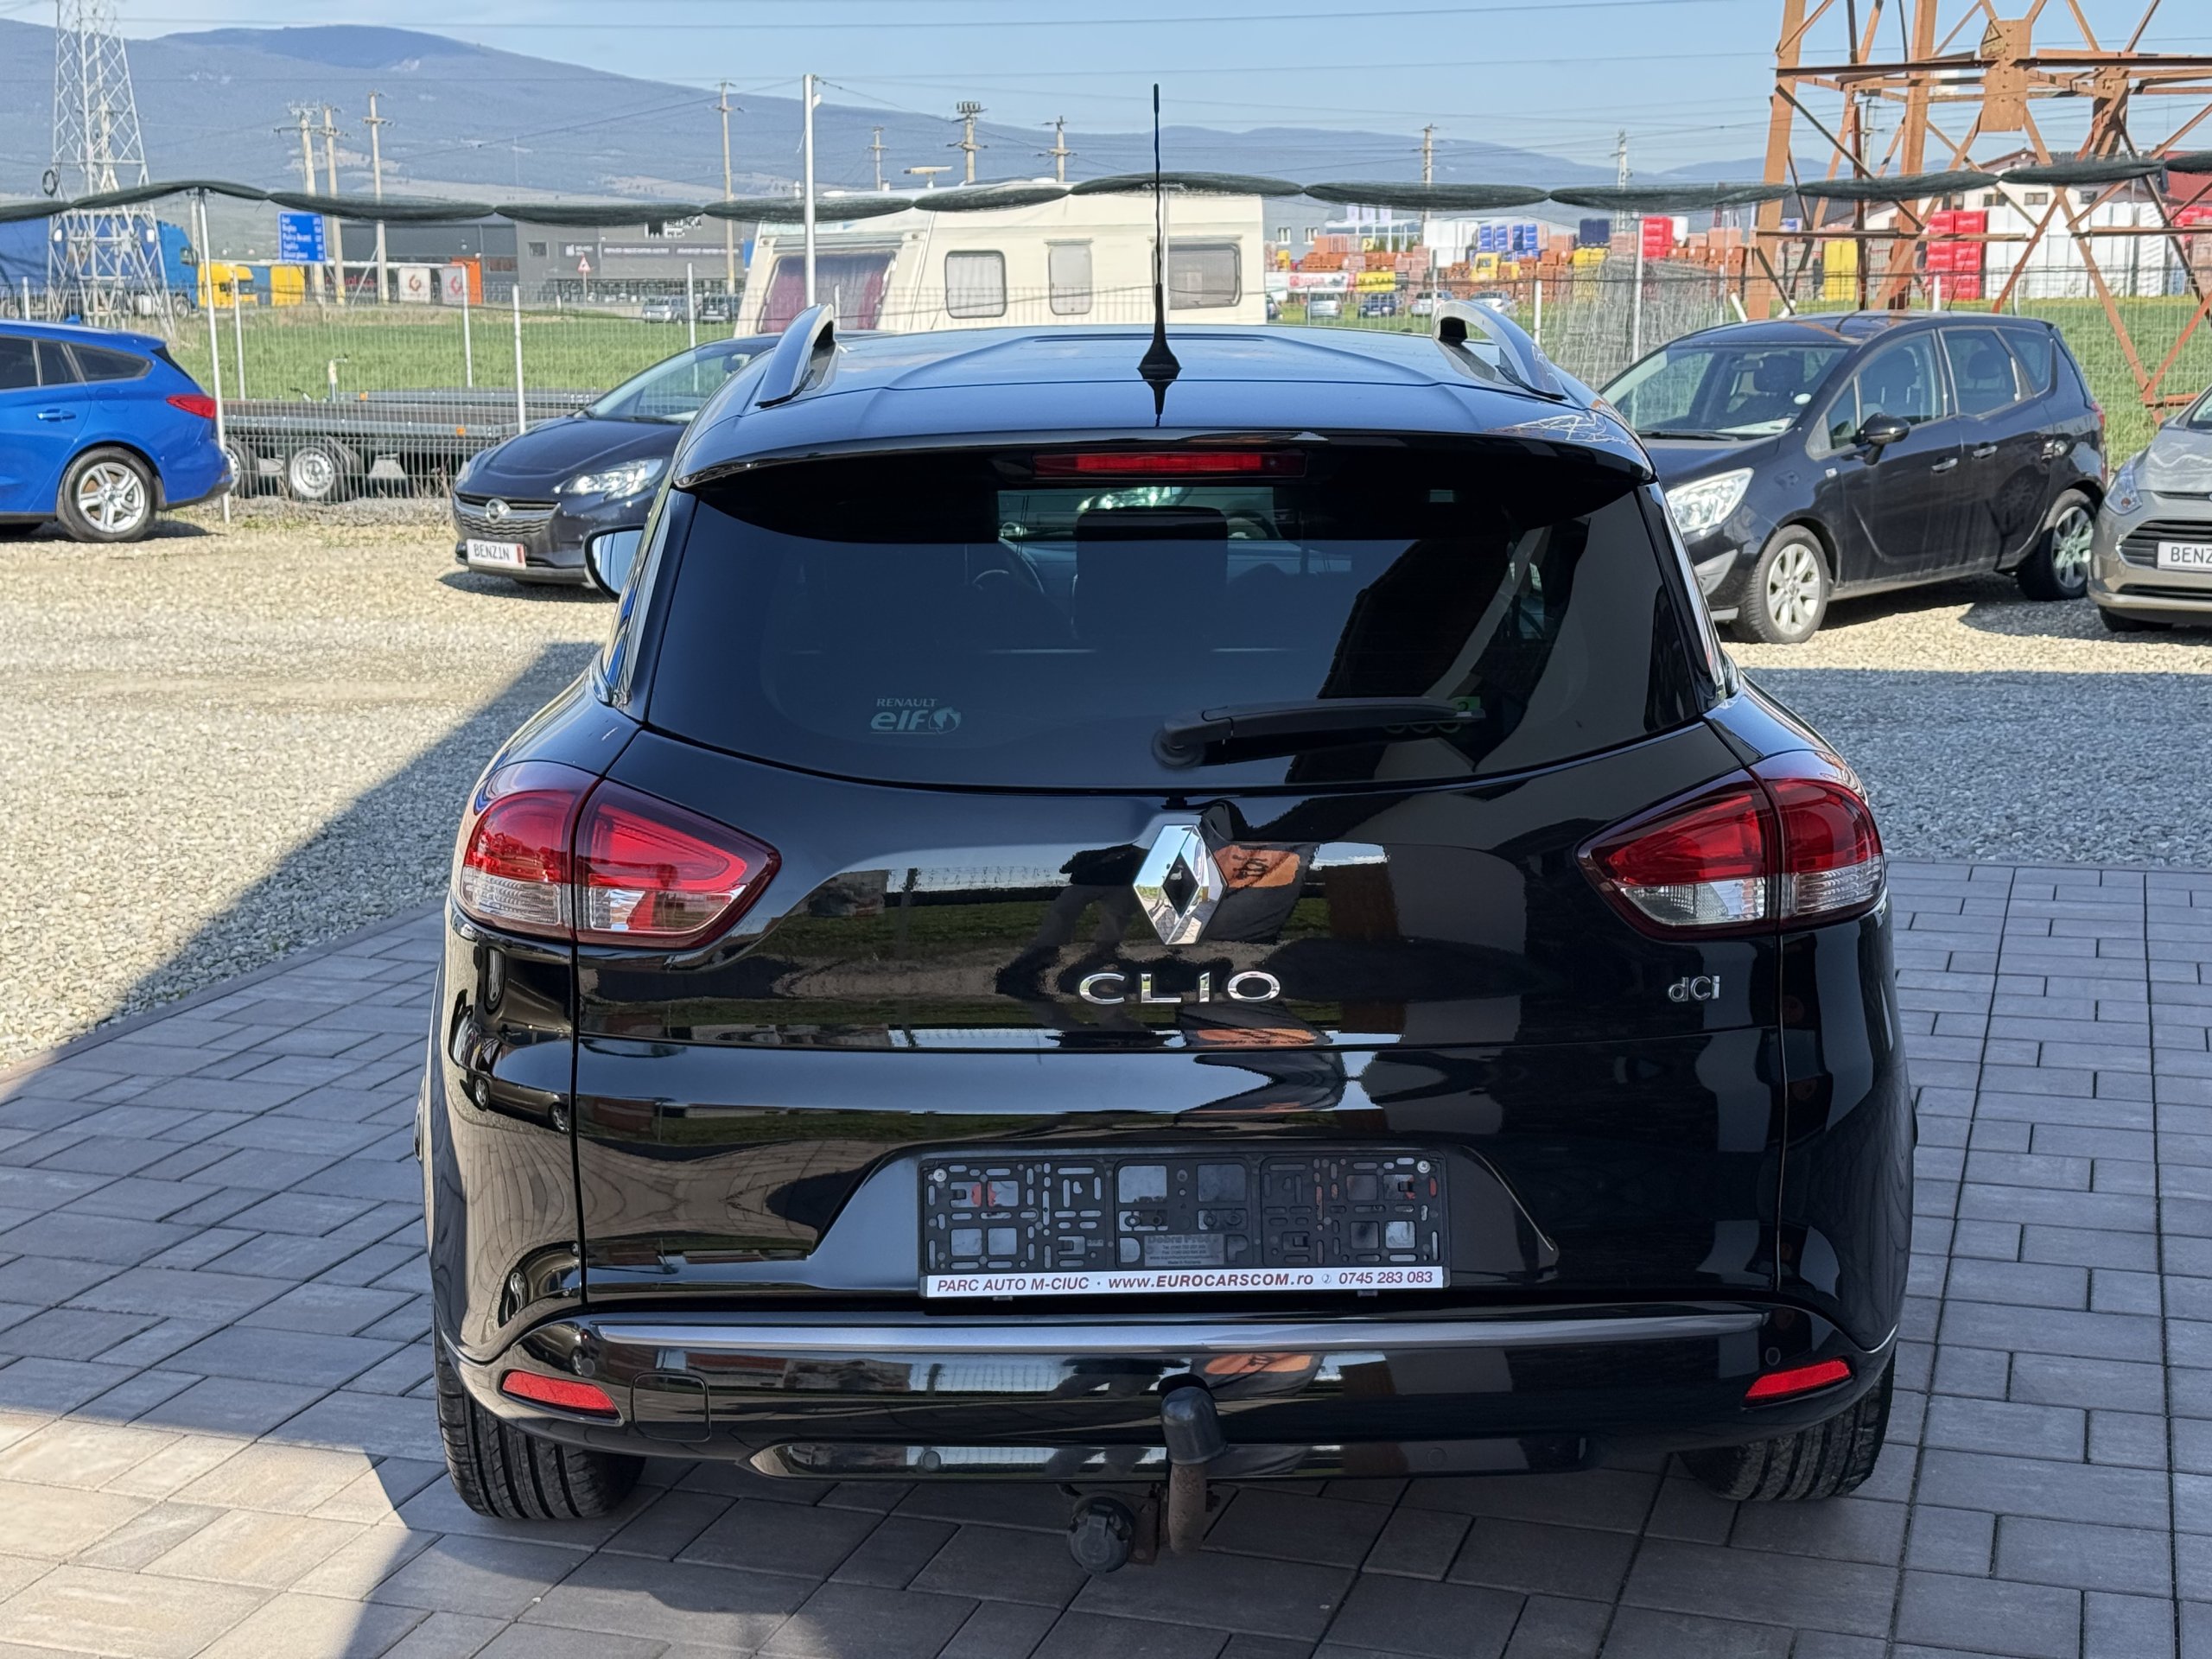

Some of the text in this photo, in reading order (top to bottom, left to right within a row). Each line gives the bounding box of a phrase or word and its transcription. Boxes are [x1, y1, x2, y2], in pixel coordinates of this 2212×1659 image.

[474, 543, 510, 560] BENZIN
[876, 697, 938, 707] RENAULT
[870, 709, 929, 731] elf
[1079, 970, 1281, 1004] CLIO
[938, 1271, 1433, 1292] PARC AUTO M-CIUC www.EUROCARSCOM.ro 0745 283 083
